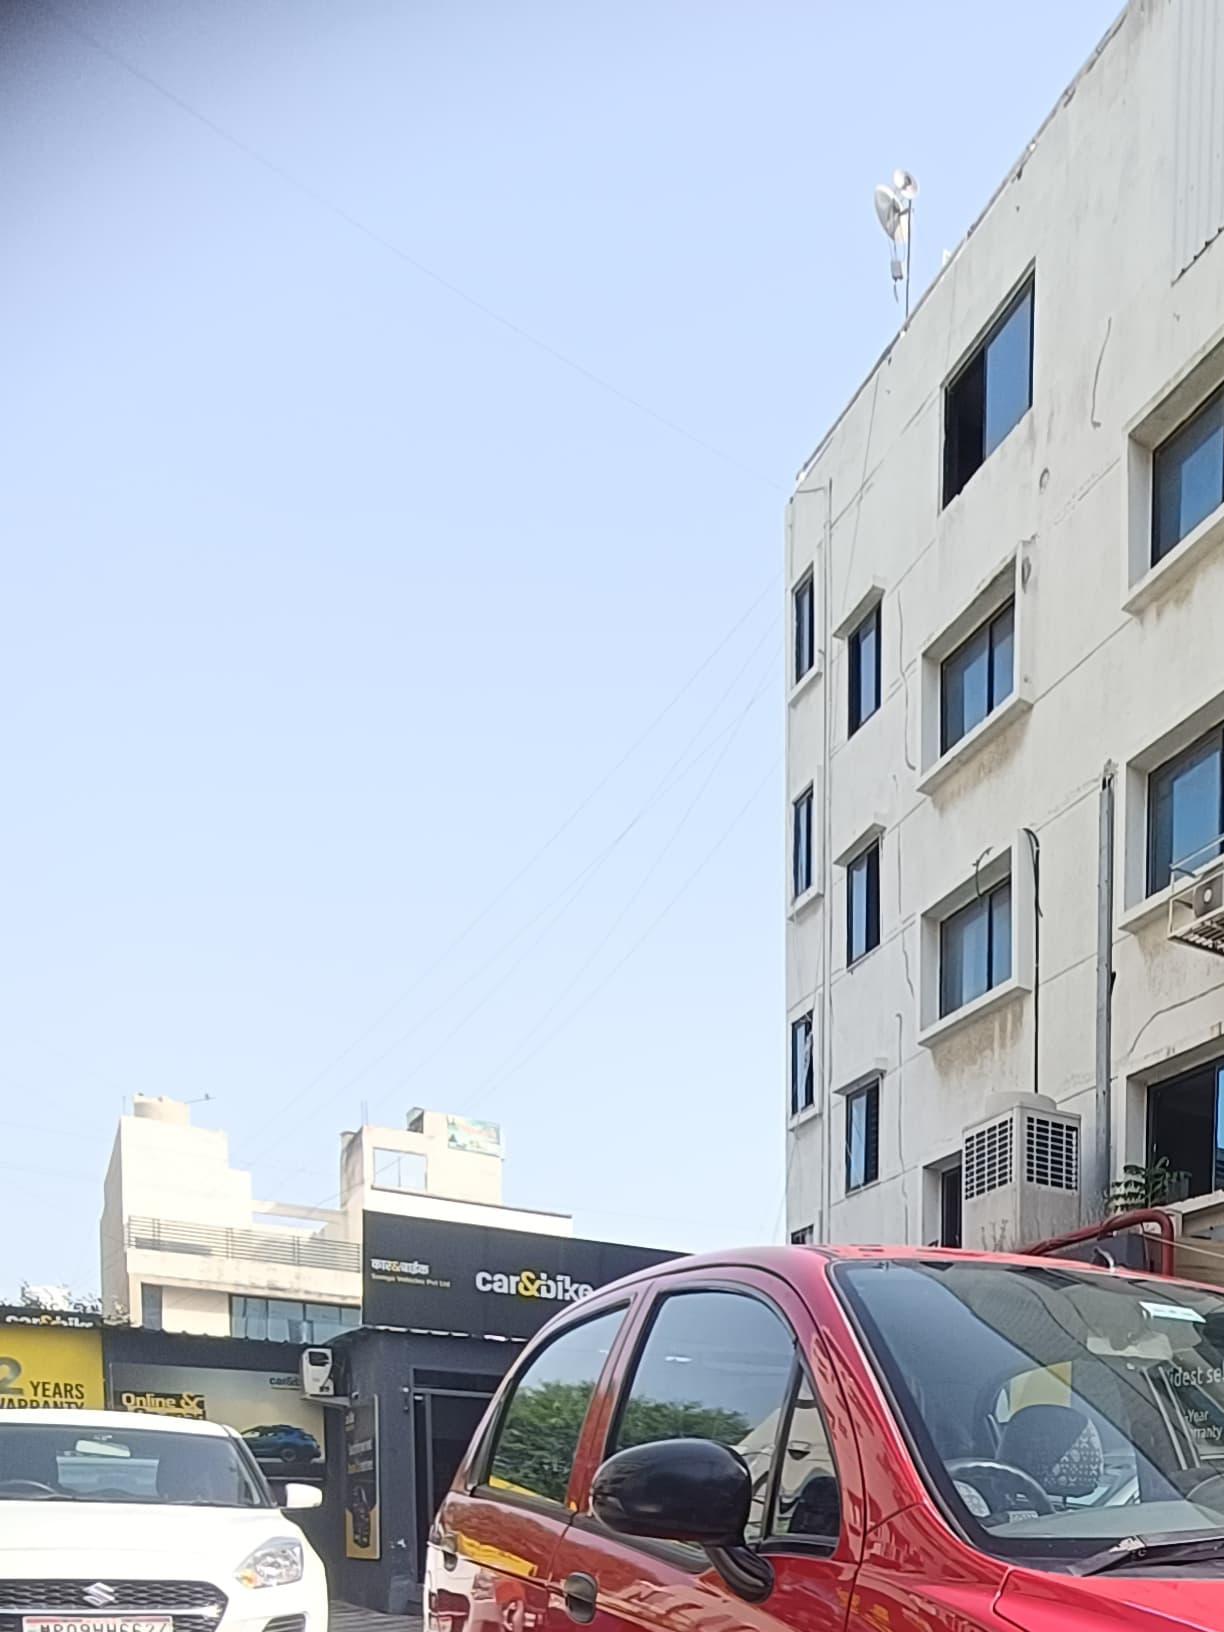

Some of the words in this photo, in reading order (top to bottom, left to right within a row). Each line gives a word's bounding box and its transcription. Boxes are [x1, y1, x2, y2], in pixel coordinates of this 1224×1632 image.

[475, 1269, 593, 1301] car&bike
[29, 1380, 85, 1400] YEARS
[121, 1392, 176, 1409] Online
